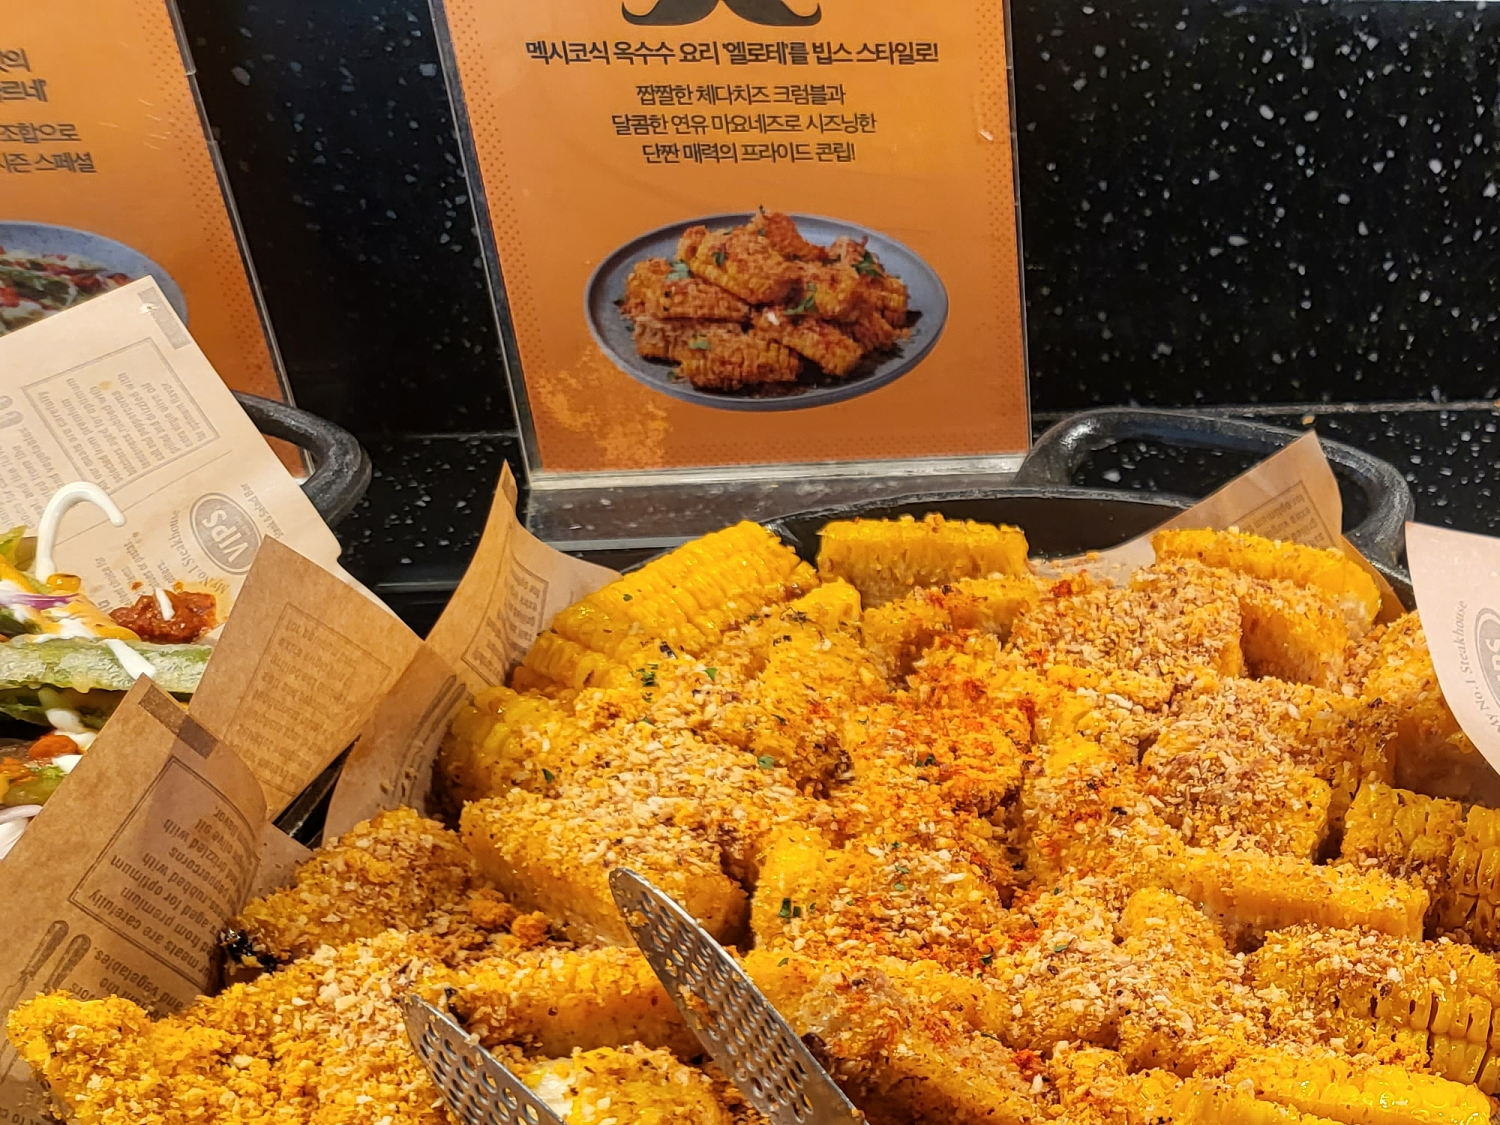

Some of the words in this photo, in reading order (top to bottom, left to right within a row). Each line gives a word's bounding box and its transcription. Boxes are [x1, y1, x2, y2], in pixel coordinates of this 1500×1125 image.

[525, 41, 609, 65] 멕시코식
[613, 42, 675, 65] 옥수수
[679, 42, 718, 65] 요리
[813, 42, 854, 65] 빕스
[856, 42, 939, 65] 스타일로!
[636, 85, 692, 105] 짭짤한
[696, 85, 770, 105] 체다치즈
[774, 85, 846, 106] 크럼블과
[612, 114, 668, 135] 달콤한
[671, 114, 707, 134] 연유
[711, 114, 801, 133] 마요네즈로
[806, 114, 877, 133] 시즈닝한
[35, 152, 97, 173] 스페셜
[643, 144, 680, 164] 단짠
[683, 144, 738, 163] 매력의
[741, 143, 813, 162] 프라이드
[816, 143, 856, 162] 콘립!
[36, 389, 68, 429] carefully
[200, 504, 252, 564] VIPS
[1451, 600, 1472, 672] Steakhouse
[160, 817, 190, 844] with
[108, 852, 165, 898] optimum
[141, 851, 169, 876] with
[86, 887, 143, 933] carefully
[117, 883, 175, 930] premium
[162, 891, 182, 909] for
[141, 924, 164, 944] are
[172, 922, 202, 947] from
[163, 939, 199, 969] meats
